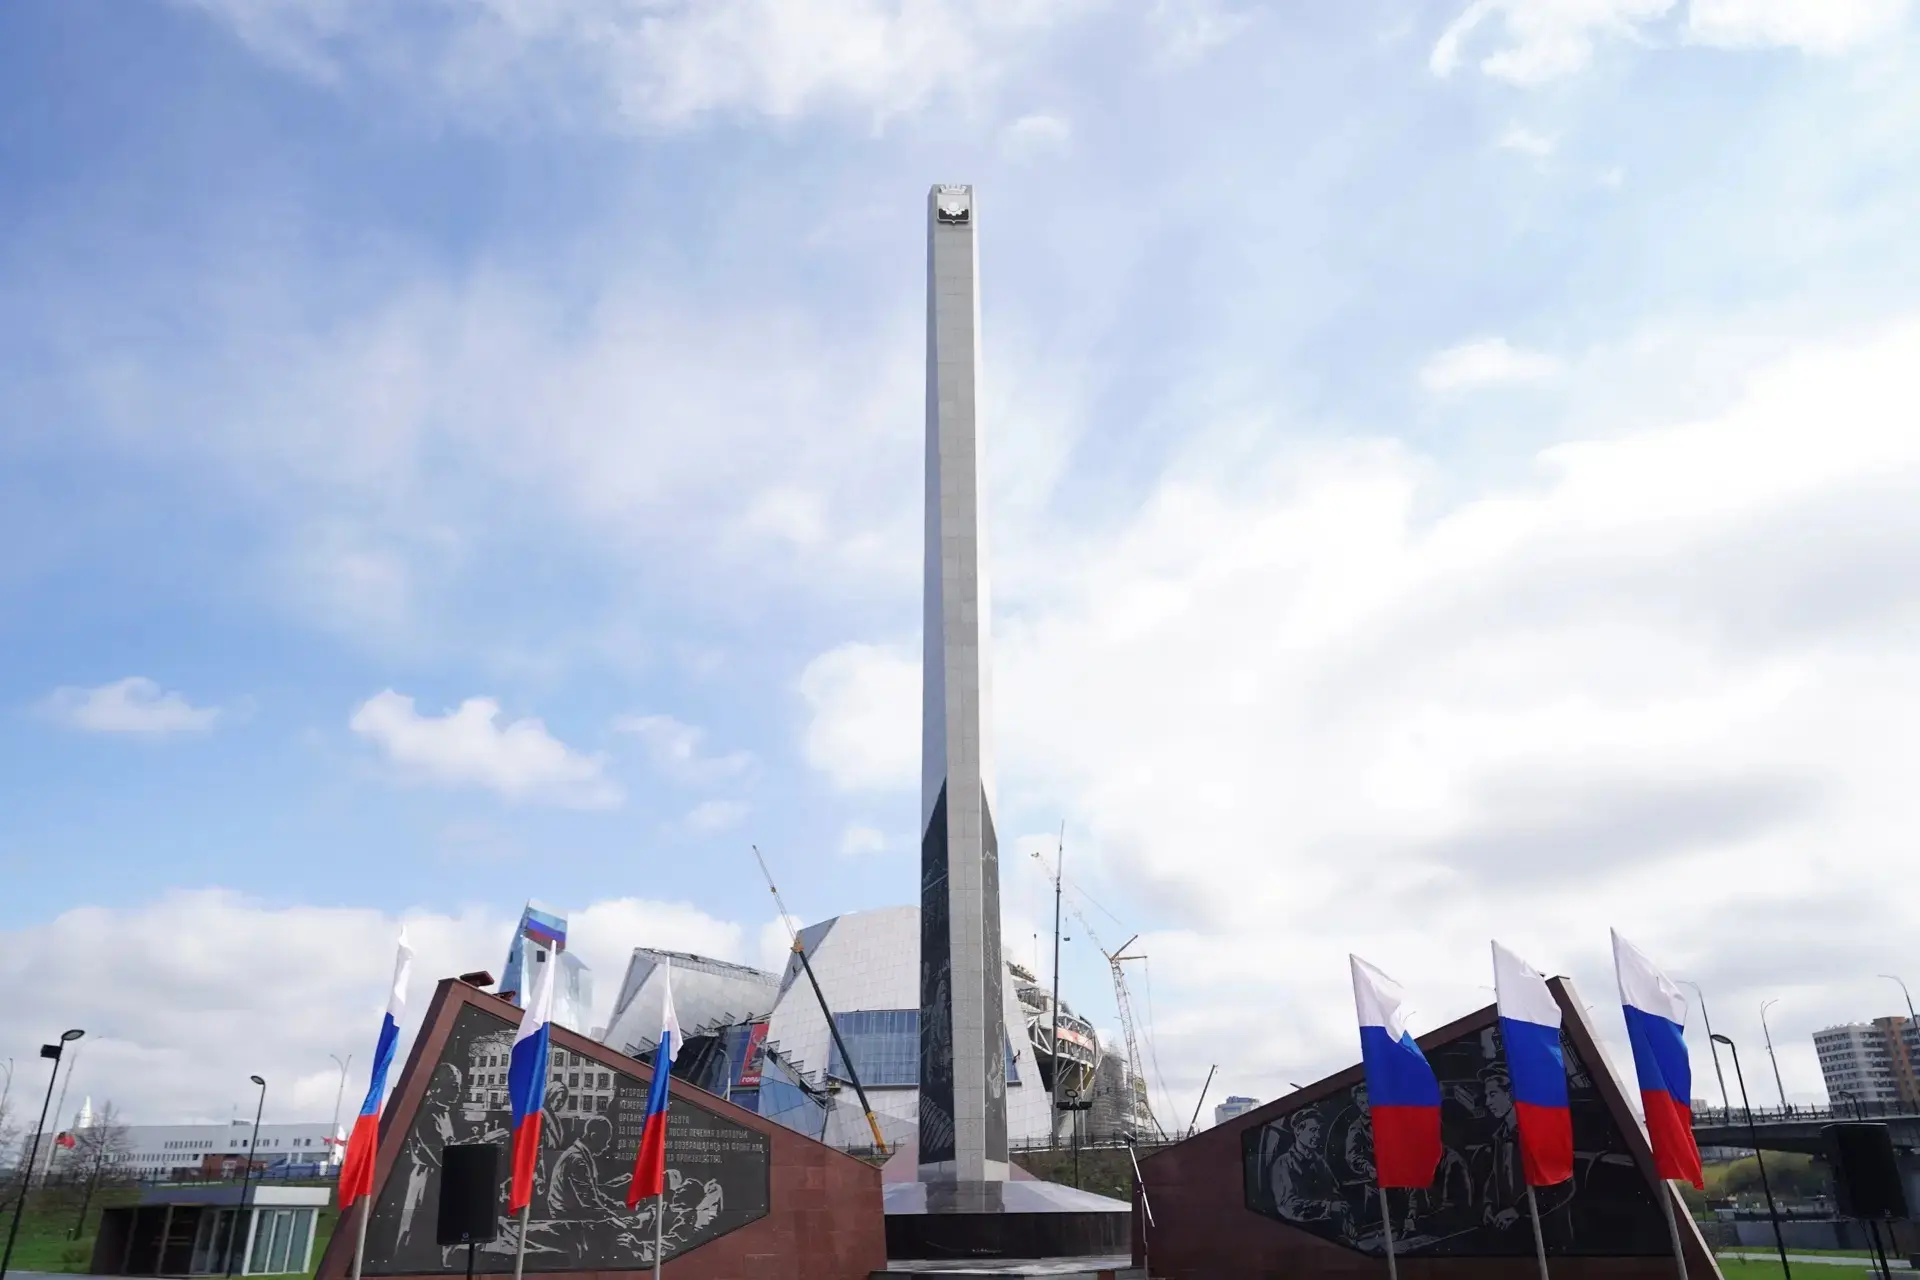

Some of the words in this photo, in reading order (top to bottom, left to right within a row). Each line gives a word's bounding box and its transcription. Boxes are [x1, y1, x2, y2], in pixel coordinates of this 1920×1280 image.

[625, 1088, 648, 1097] ГОРОДЕ
[619, 1100, 648, 1110] КЕМЕРОВ
[619, 1113, 645, 1122] ОРГАНИЗ
[667, 1115, 690, 1124] РАБОТА
